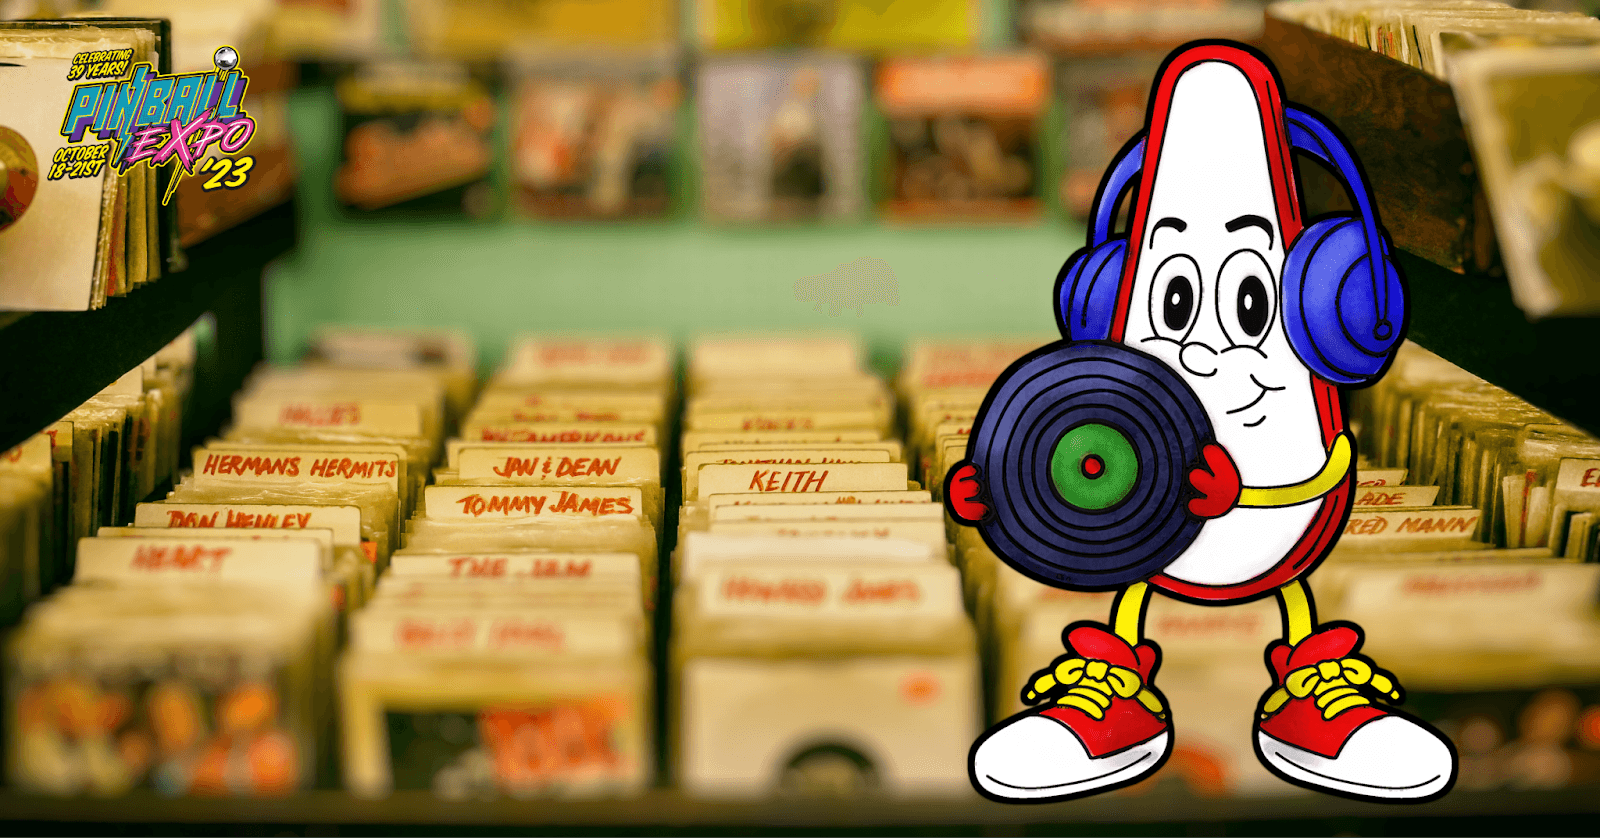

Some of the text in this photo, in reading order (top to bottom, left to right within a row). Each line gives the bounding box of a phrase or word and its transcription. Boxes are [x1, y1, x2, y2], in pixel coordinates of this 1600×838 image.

[203, 454, 397, 479] HERMANS HERMITS
[493, 456, 539, 479] JAN
[555, 456, 622, 477] DEAN
[748, 470, 829, 492] KEITH
[456, 491, 634, 517] TOMMY JAMES
[1395, 516, 1478, 534] MANN
